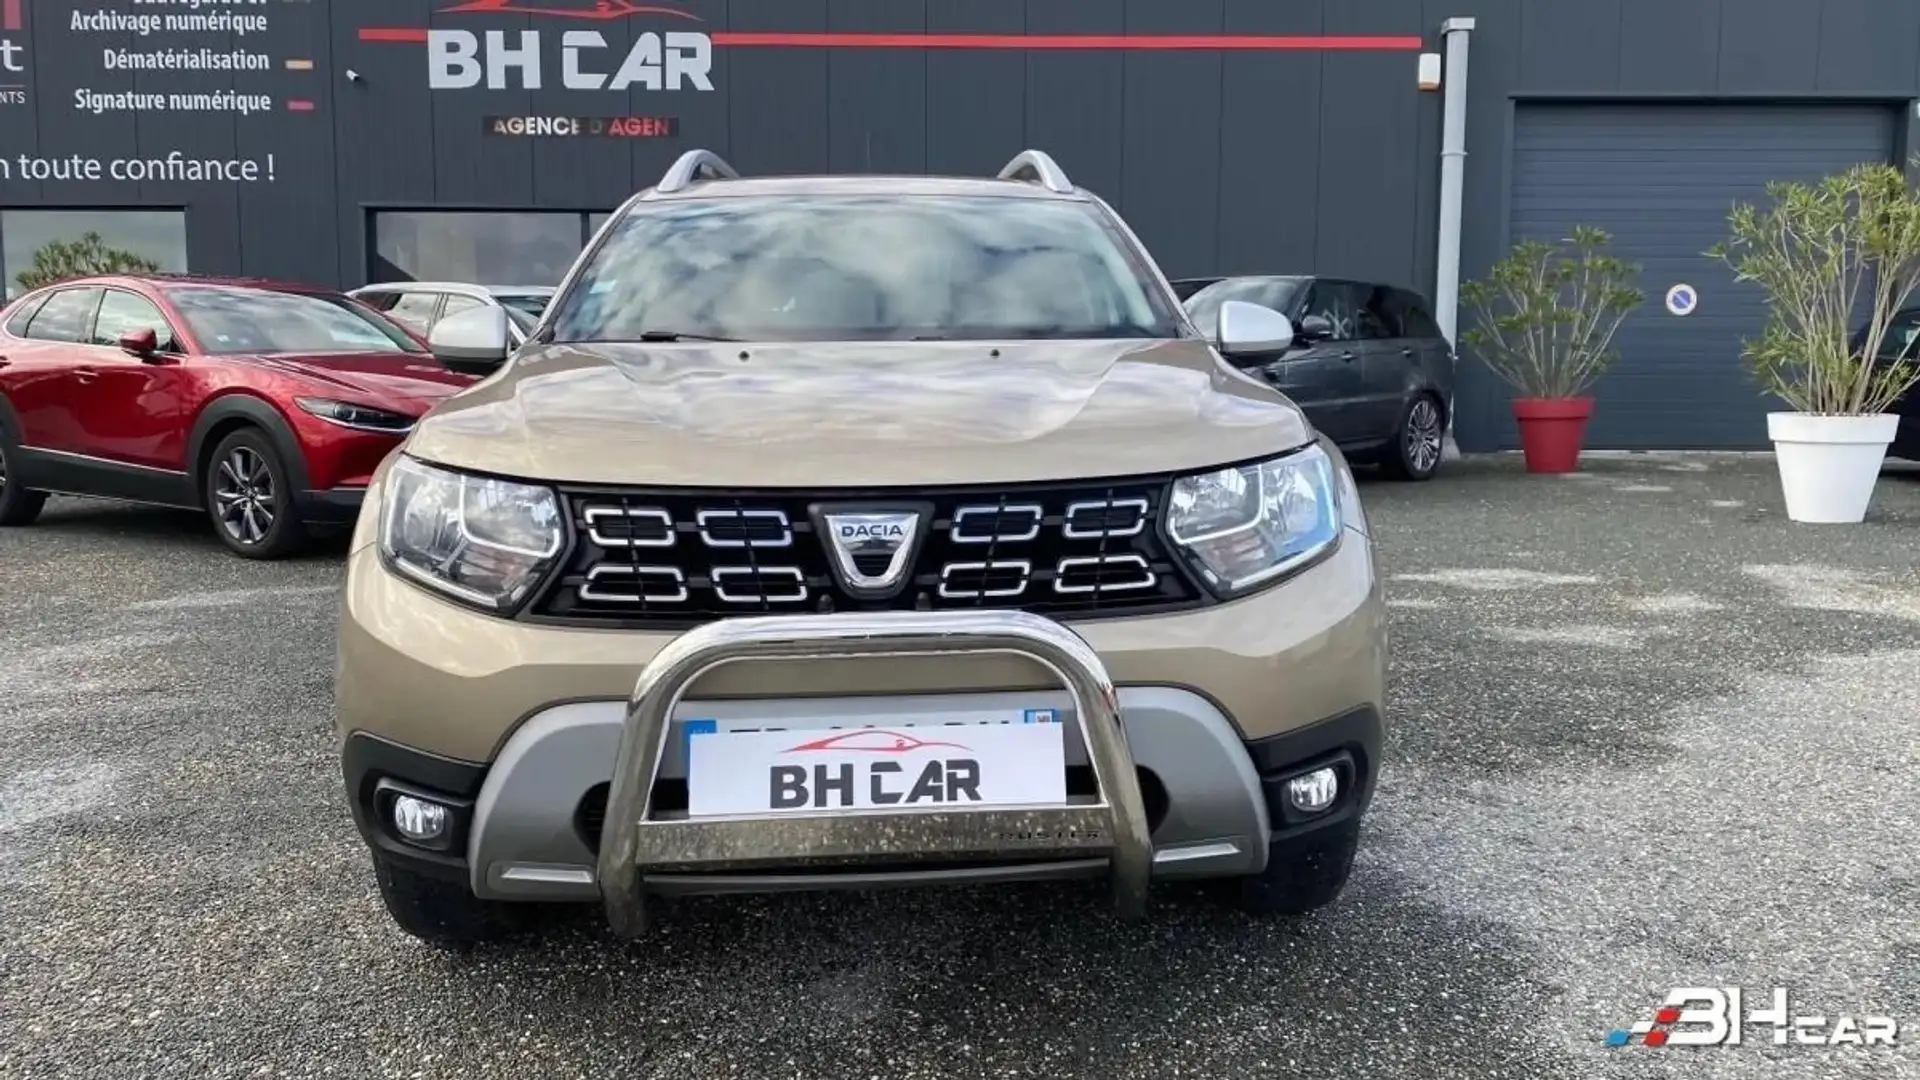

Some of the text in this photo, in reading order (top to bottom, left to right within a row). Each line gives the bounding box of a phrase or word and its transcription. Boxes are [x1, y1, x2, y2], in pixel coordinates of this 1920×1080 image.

[70, 9, 268, 36] Archivage numérique
[103, 47, 270, 70] Dématérialisation
[428, 29, 715, 91] BH CAR
[74, 88, 272, 115] Signature numérique
[17, 153, 102, 180] toute
[110, 151, 259, 181] confiance
[841, 525, 904, 537] DACIA
[770, 759, 982, 809] BH CAR
